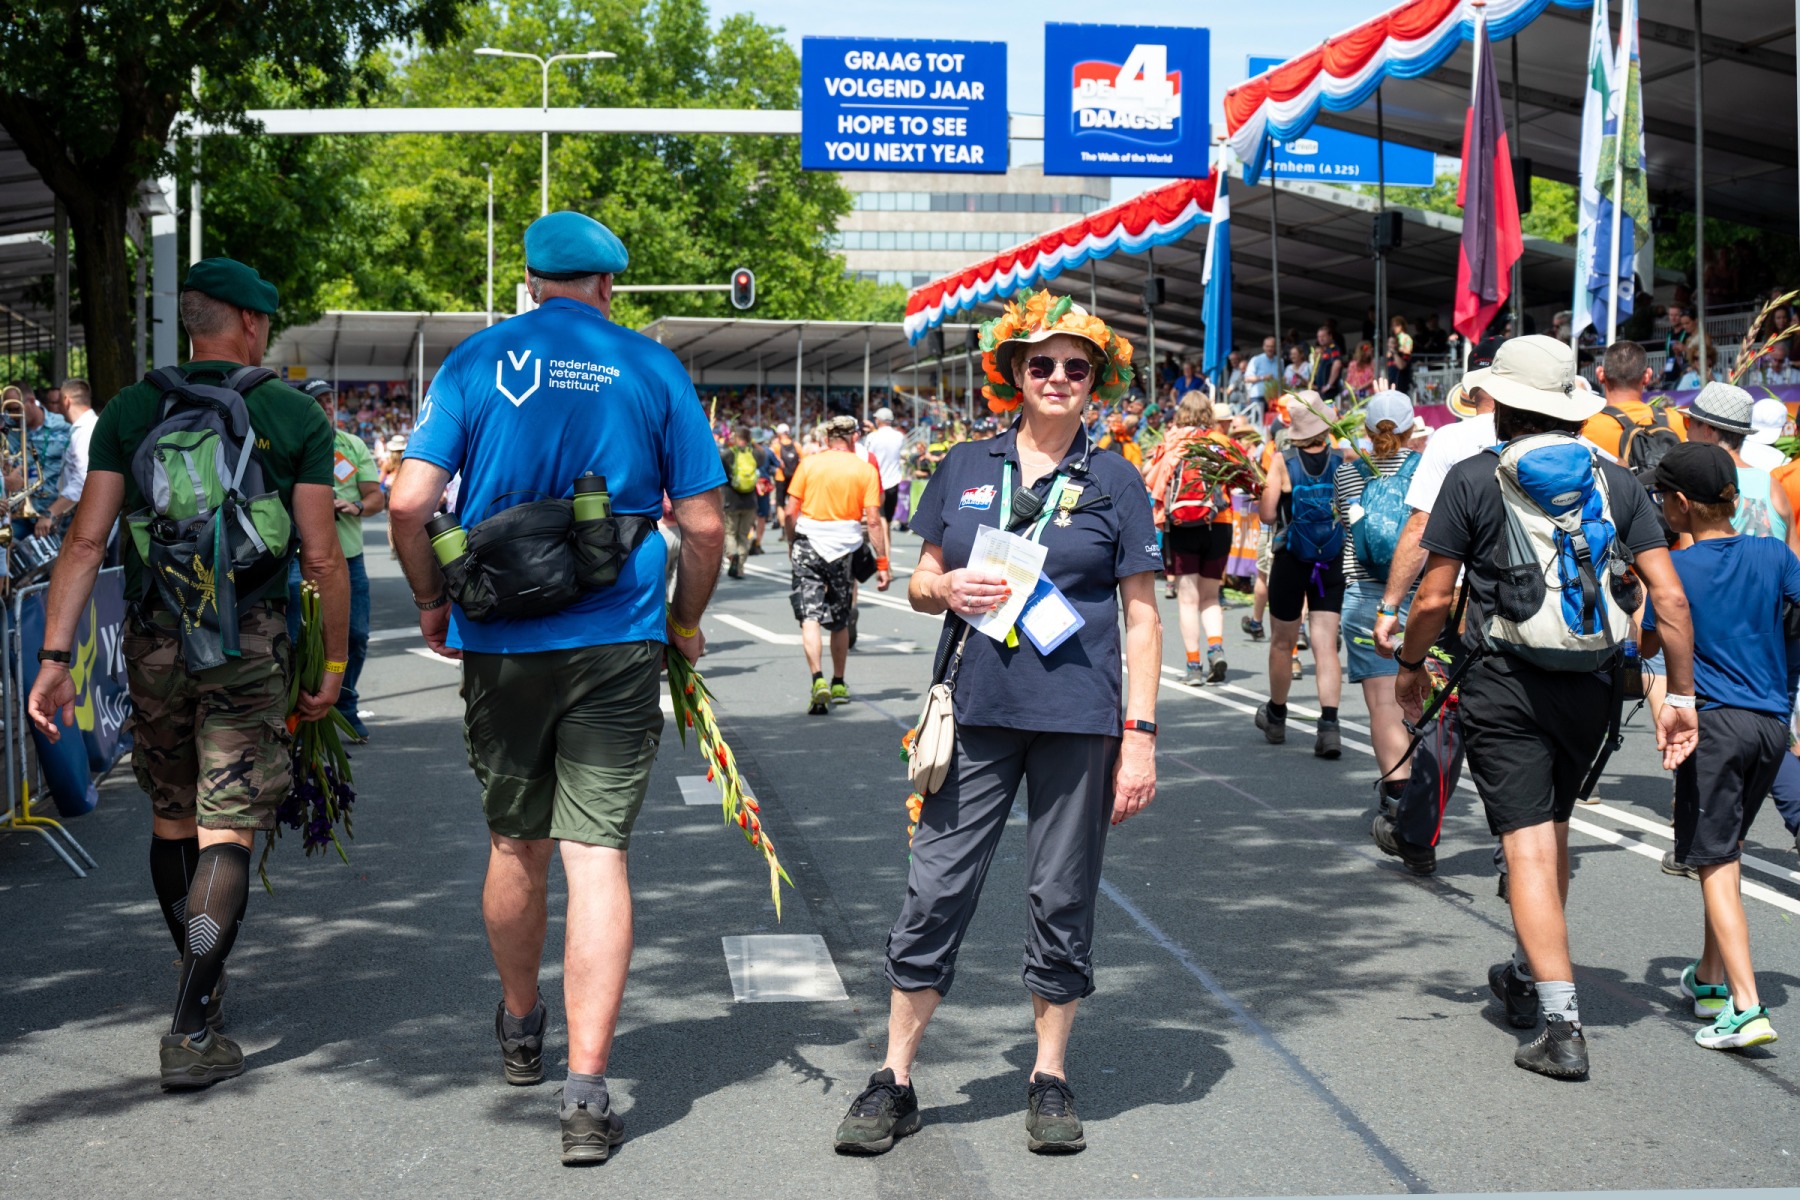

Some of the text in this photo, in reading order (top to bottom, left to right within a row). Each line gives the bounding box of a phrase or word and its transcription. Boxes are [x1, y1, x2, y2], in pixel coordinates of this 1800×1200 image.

[844, 50, 965, 73] GRAAG TOT
[1115, 43, 1174, 110] 4
[824, 77, 985, 101] VOLGEND JAAR
[837, 114, 968, 137] HOPE TO SEE
[1080, 108, 1174, 130] DAAGSE
[824, 141, 985, 164] YOU NEXT YEAR
[1080, 151, 1173, 164] The Walk of the World
[1264, 158, 1315, 174] Arnhem
[549, 359, 620, 378] nederlands
[549, 368, 613, 385] veteranen
[548, 378, 600, 392] instituut
